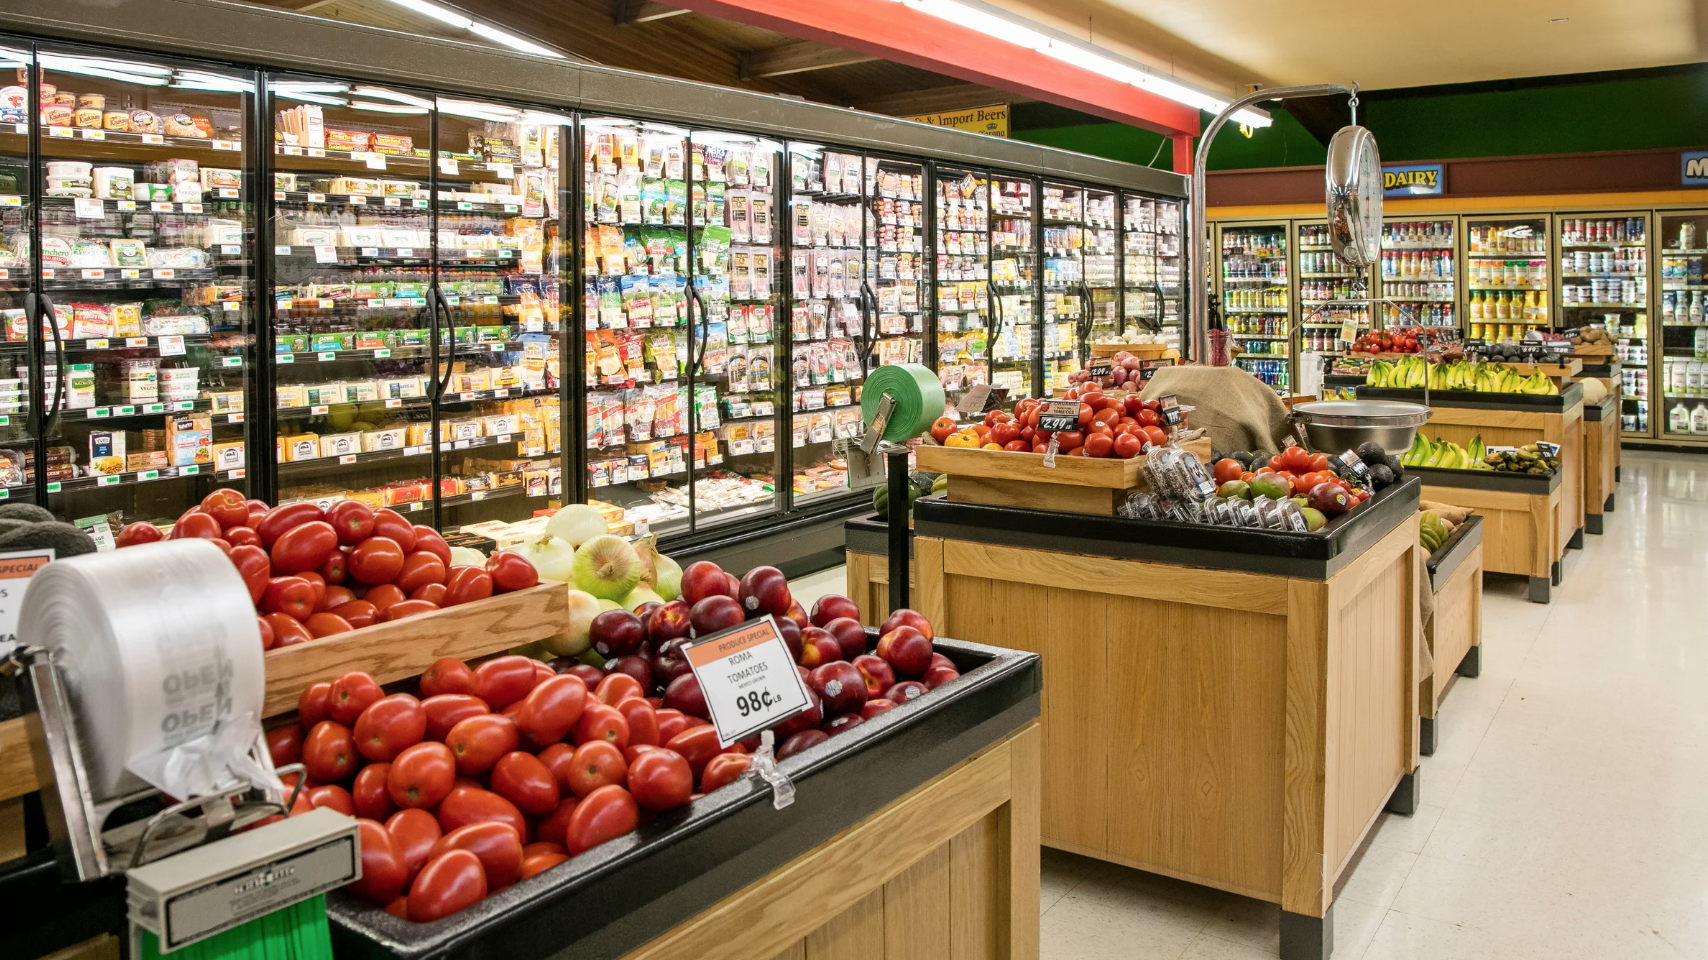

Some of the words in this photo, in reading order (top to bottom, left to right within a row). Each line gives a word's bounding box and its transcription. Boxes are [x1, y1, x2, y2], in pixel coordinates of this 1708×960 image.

[938, 114, 975, 127] Import
[976, 109, 1007, 122] Beers
[1383, 170, 1438, 189] DAIRY
[718, 637, 746, 652] PRODUCE
[747, 628, 770, 643] SPECIAL
[728, 650, 753, 666] ROMA
[727, 661, 768, 684] TOMATOES
[738, 680, 752, 689] MEXICO
[752, 675, 766, 685] GROWN
[736, 686, 773, 717] 98¢
[773, 694, 782, 703] LB
